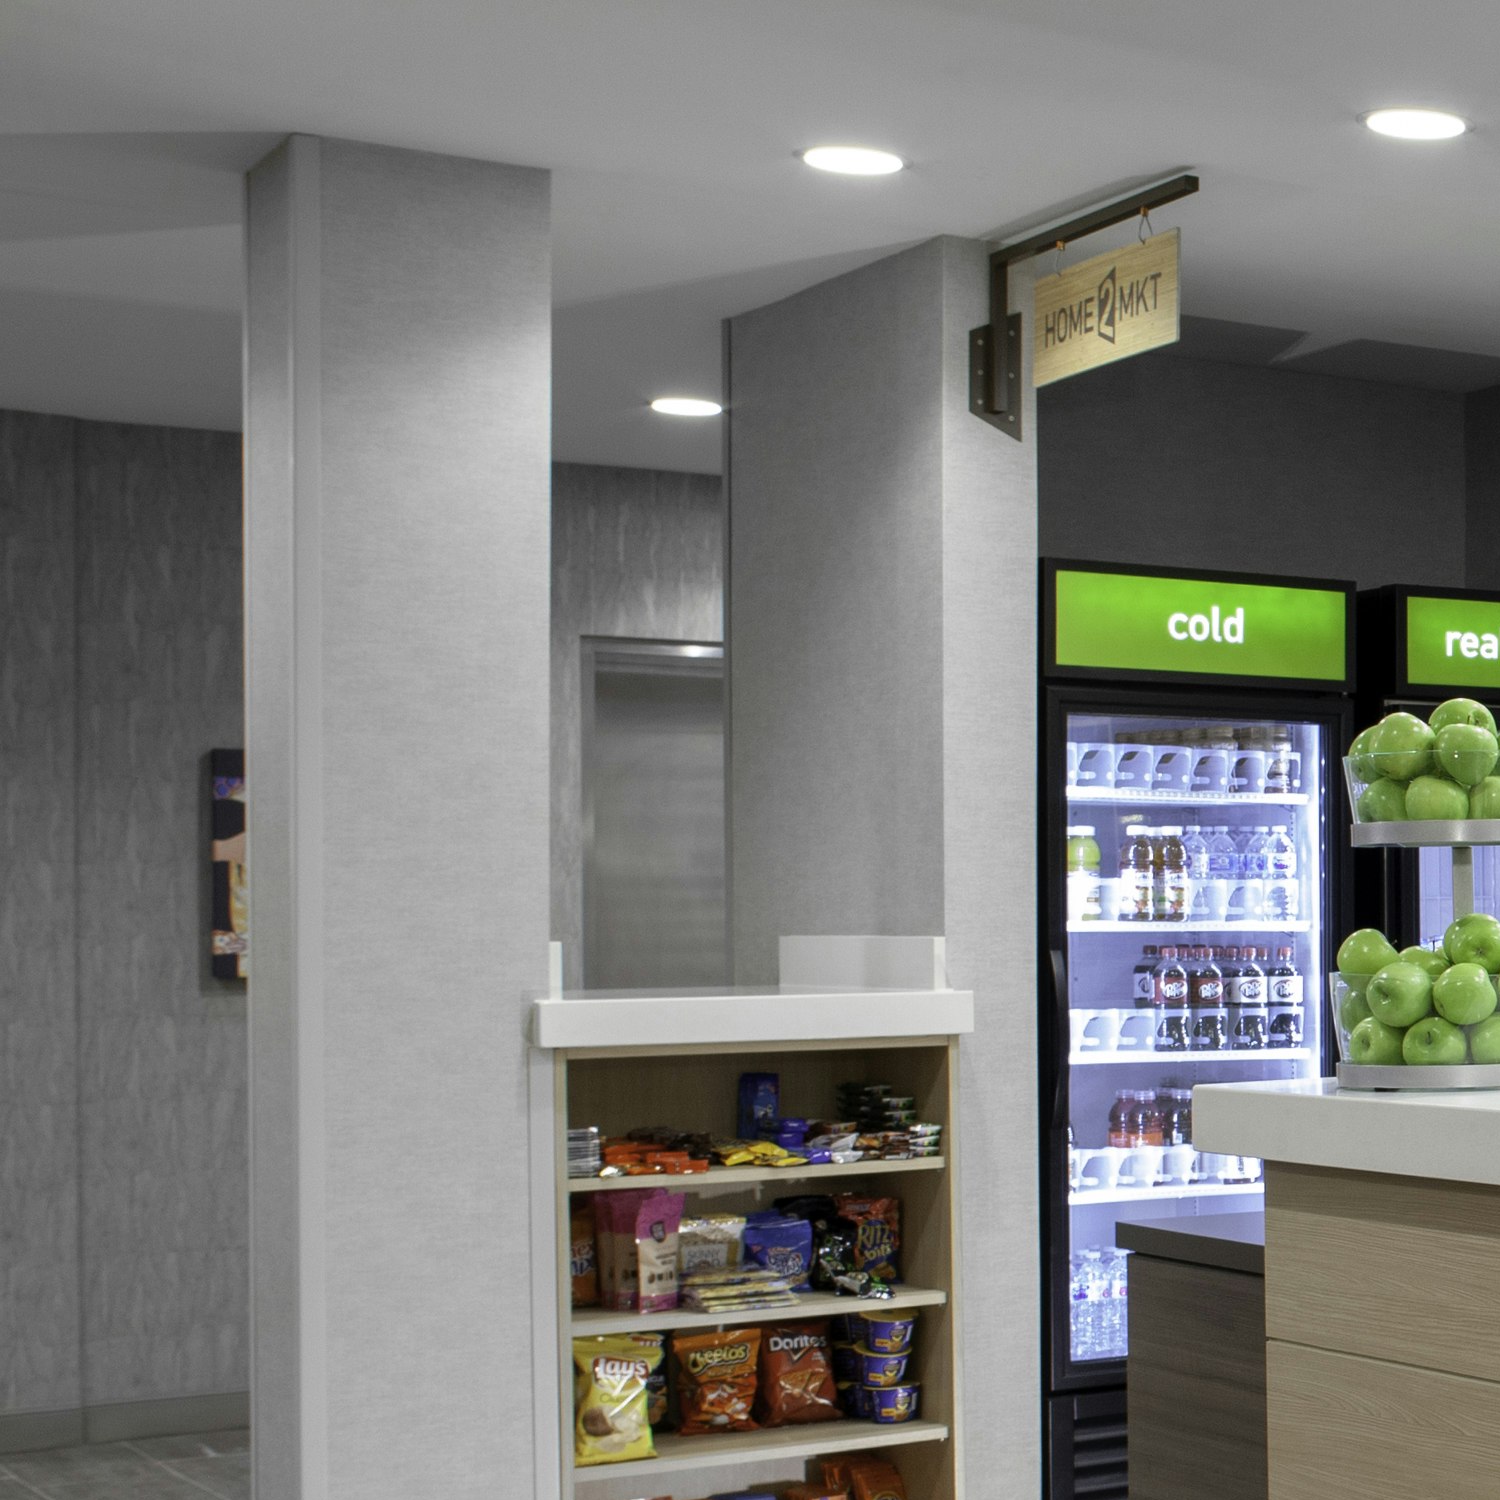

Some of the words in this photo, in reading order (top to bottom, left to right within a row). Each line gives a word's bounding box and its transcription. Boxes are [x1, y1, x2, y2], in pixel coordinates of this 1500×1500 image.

[1167, 605, 1245, 644] cold
[857, 1224, 893, 1250] RITZ
[769, 1335, 827, 1352] Doritos
